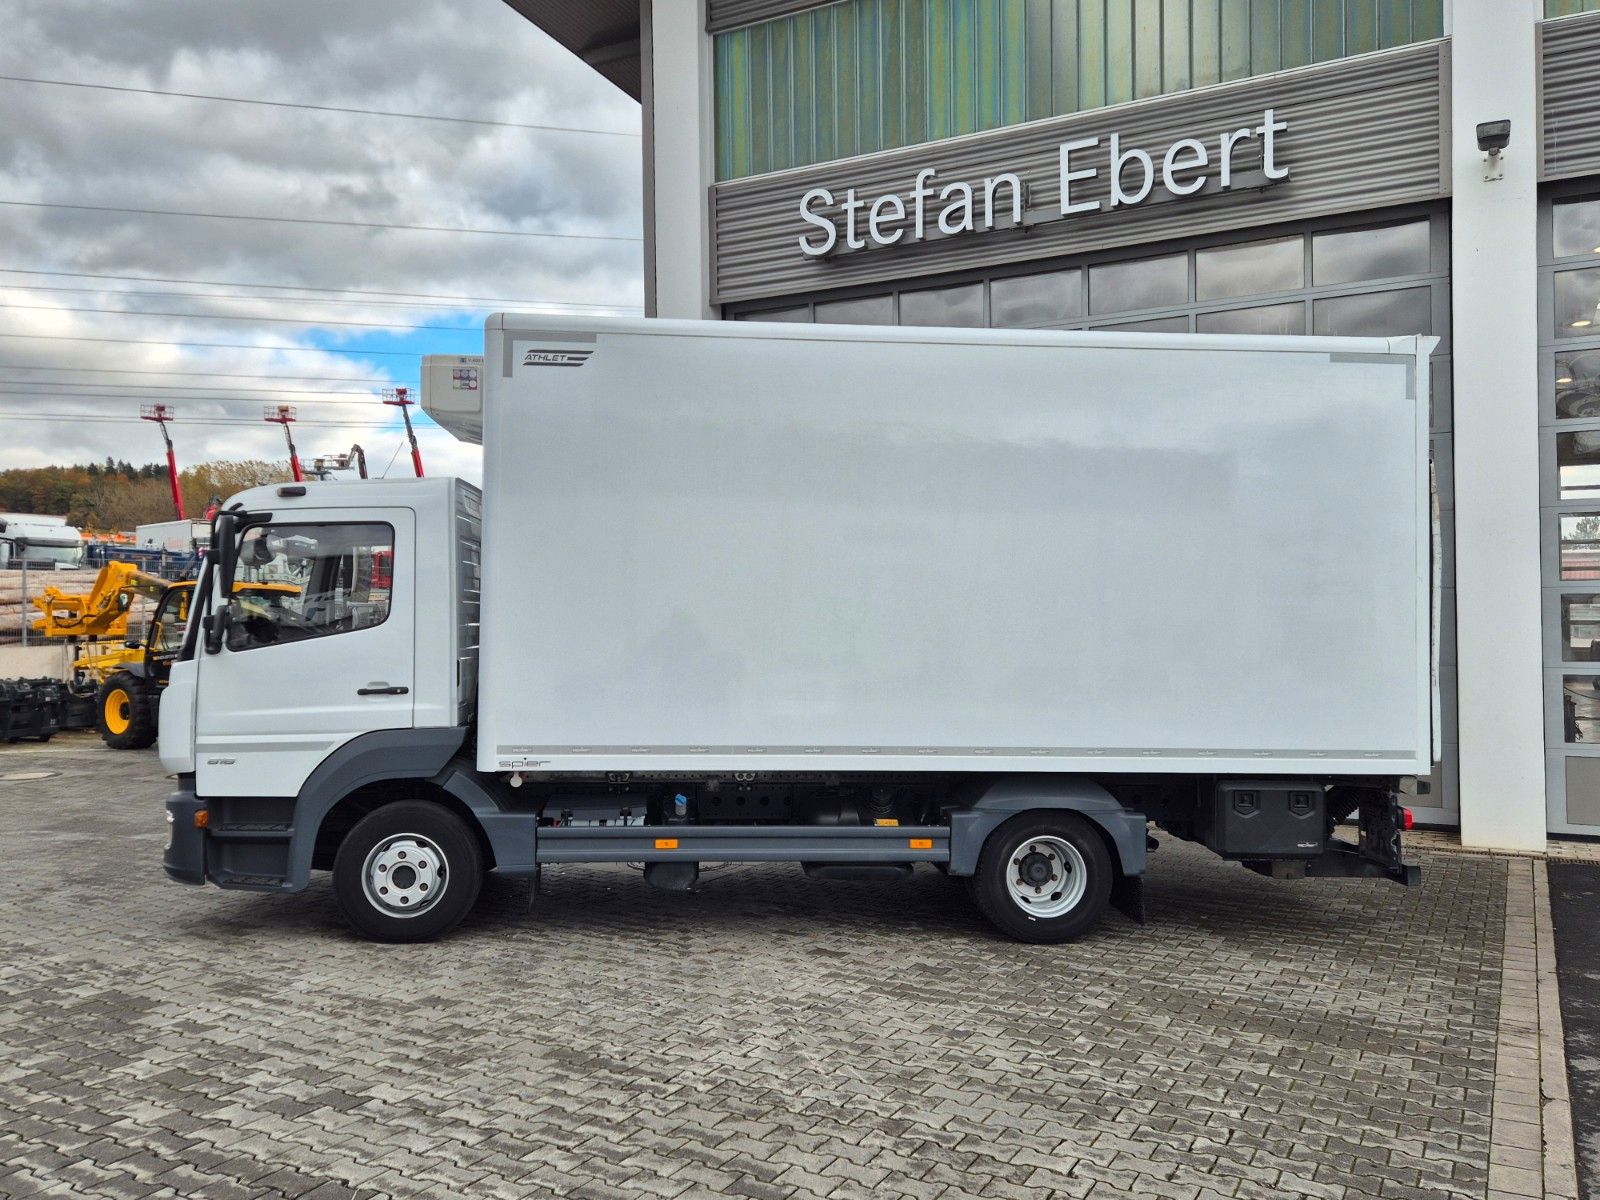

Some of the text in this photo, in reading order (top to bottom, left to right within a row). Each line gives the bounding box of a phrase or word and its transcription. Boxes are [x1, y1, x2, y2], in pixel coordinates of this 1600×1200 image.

[798, 108, 1290, 257] Stefan Ebert
[524, 353, 567, 362] ATHLET
[498, 757, 551, 769] spier
